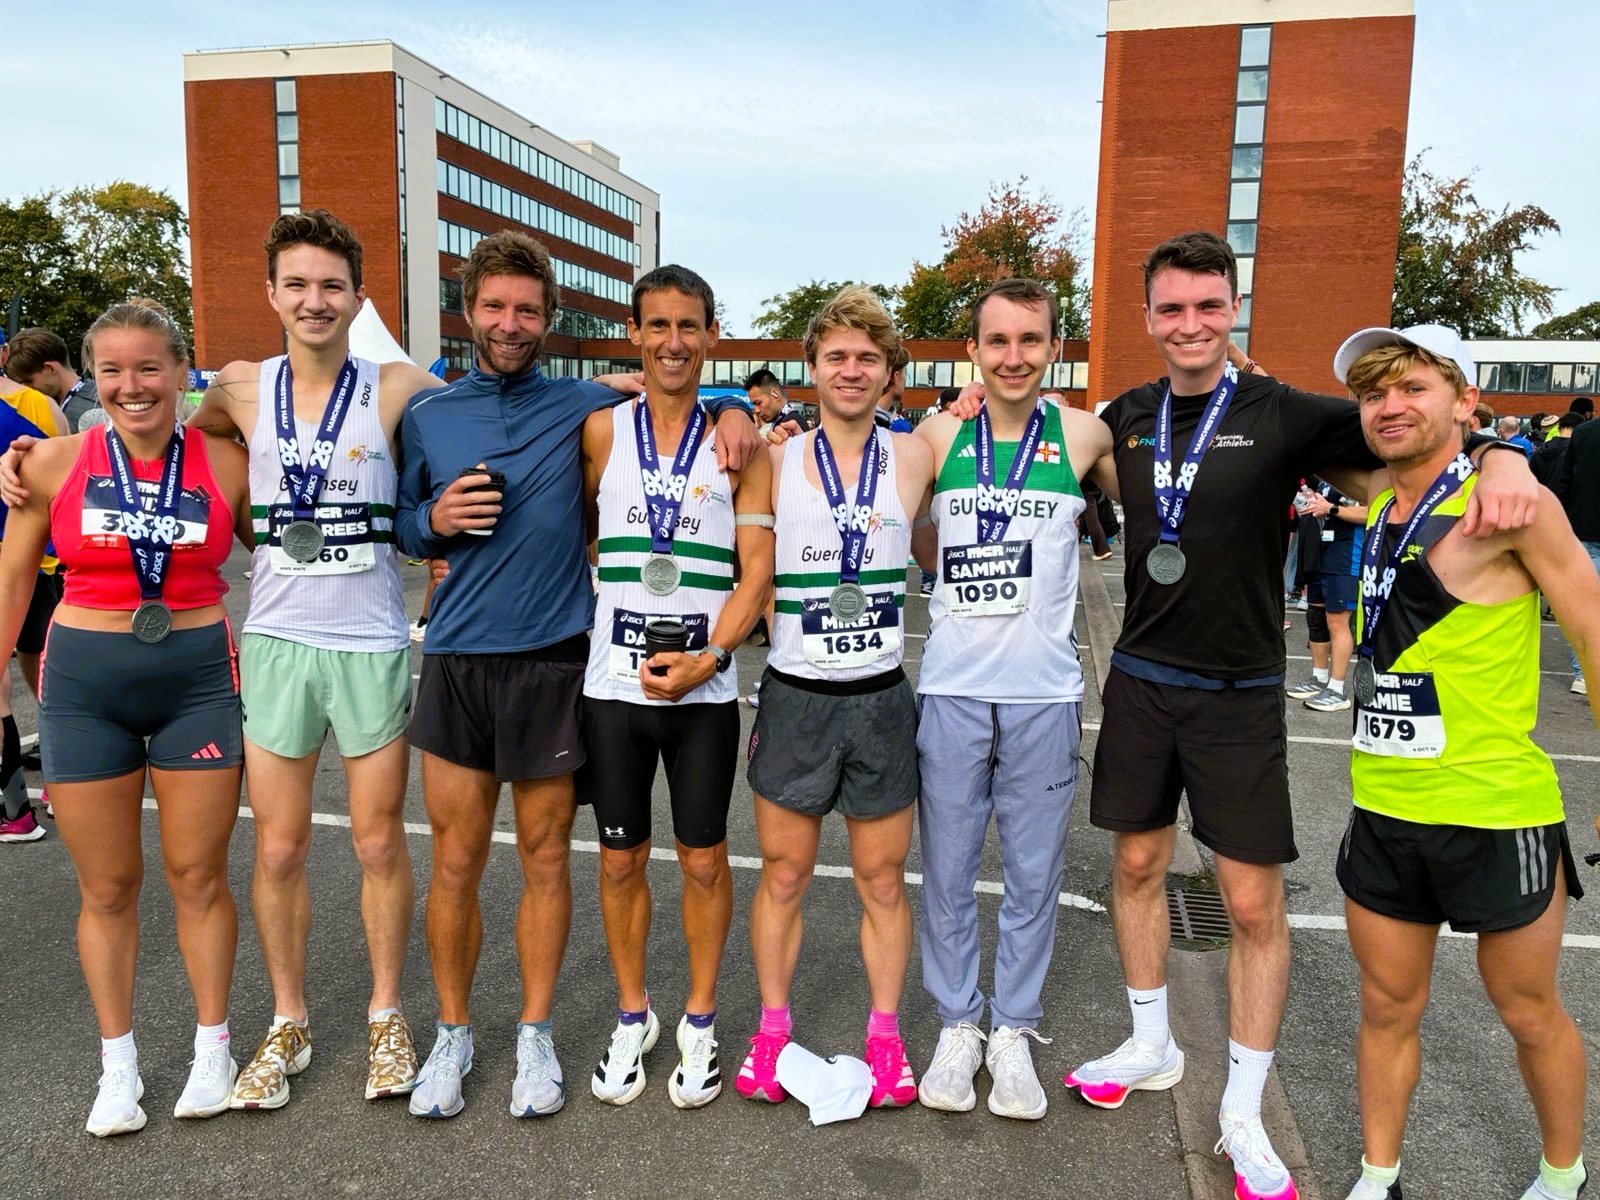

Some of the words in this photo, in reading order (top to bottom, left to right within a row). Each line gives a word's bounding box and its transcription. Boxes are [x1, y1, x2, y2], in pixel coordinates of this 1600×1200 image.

[280, 366, 288, 410] MANCHESTER
[326, 388, 347, 432] MANCHESTER
[343, 370, 352, 388] HALF
[361, 382, 373, 408] soar
[640, 407, 650, 443] MANCHESTER
[1193, 406, 1219, 454] MANCHESTER
[1217, 387, 1228, 407] HALF
[680, 425, 699, 467] MANCHESTER
[818, 438, 826, 454] HALF
[981, 415, 989, 457] MANCHESTER
[1014, 437, 1034, 481] MANCHESTER
[1030, 418, 1039, 437] HALF
[1216, 439, 1254, 448] Athletics
[278, 438, 300, 467] 26
[310, 440, 334, 470] 26
[644, 444, 652, 462] HALF
[878, 447, 889, 475] soar
[982, 458, 990, 476] HALF
[112, 438, 128, 484] MANCHESTER
[123, 485, 134, 504] HALF
[164, 463, 177, 508] MANCHESTER
[172, 443, 180, 463] HALF
[642, 468, 663, 497] 26
[821, 454, 838, 497] MANCHESTER
[863, 451, 876, 497] MANCHESTER
[1154, 460, 1172, 489] 26
[1176, 462, 1199, 492] 26
[280, 476, 358, 496] Gnsey
[664, 474, 687, 502] 26
[978, 483, 996, 512] 26
[344, 508, 364, 516] HALF
[950, 498, 1058, 519] GUSEY
[996, 488, 1020, 517] 26
[122, 510, 150, 540] 26
[151, 515, 176, 544] 26
[321, 522, 368, 536] REES
[627, 506, 701, 534] Gusey
[852, 504, 872, 534] 26
[1395, 504, 1430, 558] MANCHESTER
[1427, 484, 1448, 505] HALF
[802, 545, 874, 564] Guery
[1371, 533, 1380, 556] HALF
[950, 559, 1020, 580] SAMMY
[1363, 565, 1377, 598] 26
[1378, 566, 1396, 600] 26
[875, 596, 890, 604] HALF
[955, 581, 1018, 604] 1090
[627, 617, 644, 625] asics
[684, 618, 702, 626] HALF
[624, 629, 696, 648] DAY
[822, 632, 884, 654] 1634
[1402, 678, 1424, 686] HALF
[1365, 692, 1412, 712] AMIE
[1364, 715, 1416, 742] 1679
